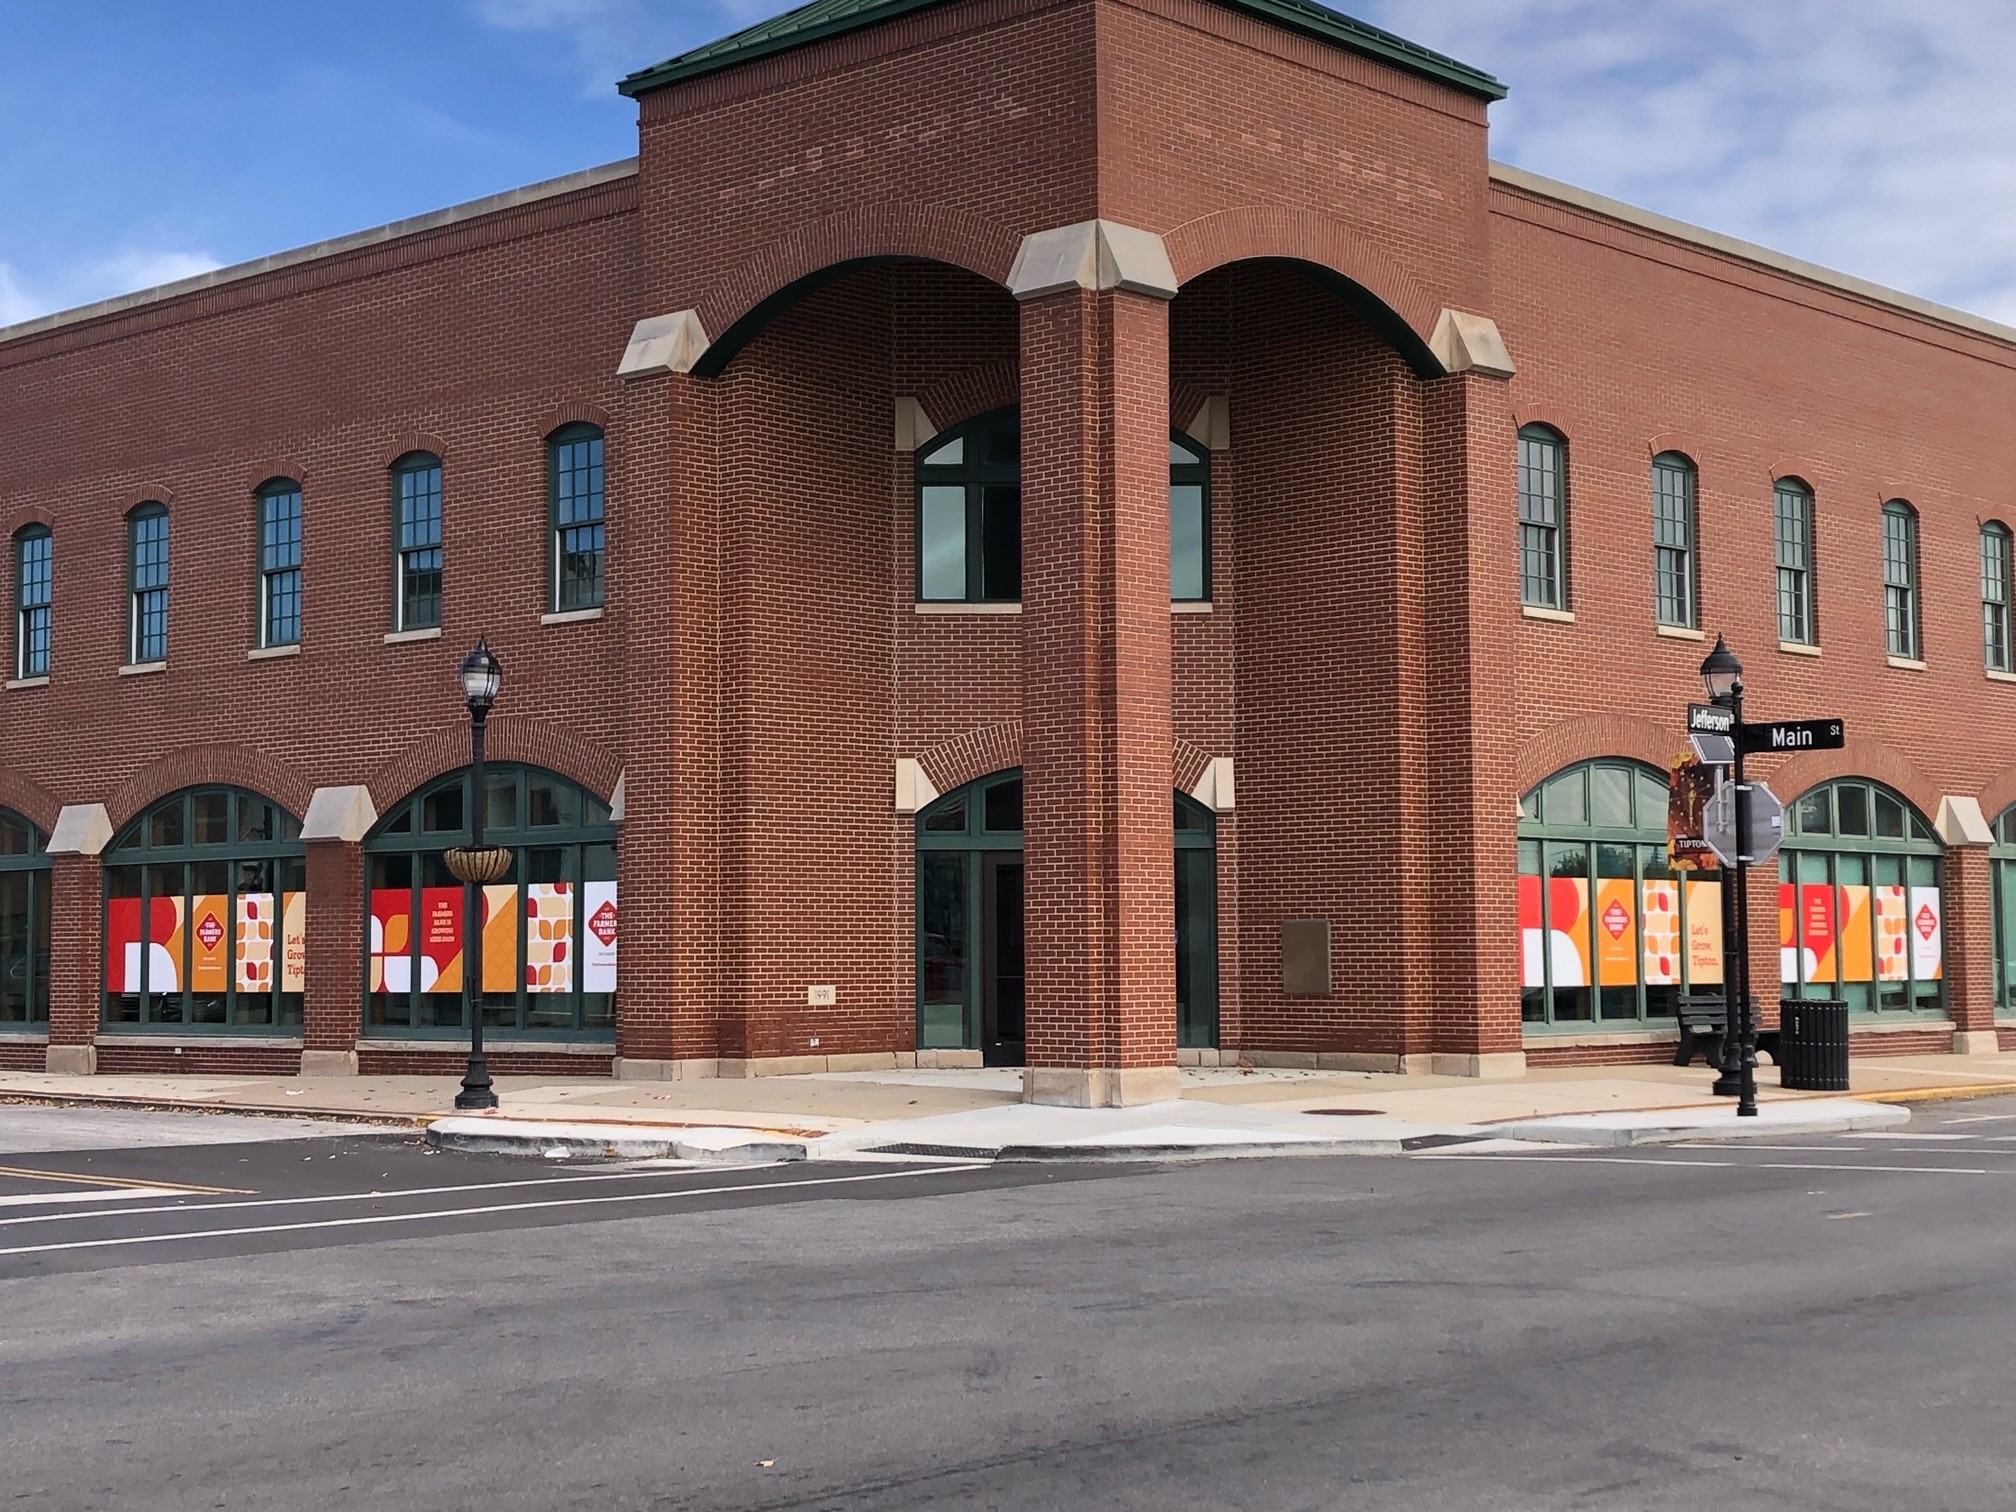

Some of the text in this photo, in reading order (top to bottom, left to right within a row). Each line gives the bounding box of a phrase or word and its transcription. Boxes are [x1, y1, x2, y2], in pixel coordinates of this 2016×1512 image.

[1690, 708, 1730, 732] Jefferson
[1772, 724, 1840, 747] Main St
[598, 928, 617, 936] BANK
[1691, 924, 1709, 936] Let's
